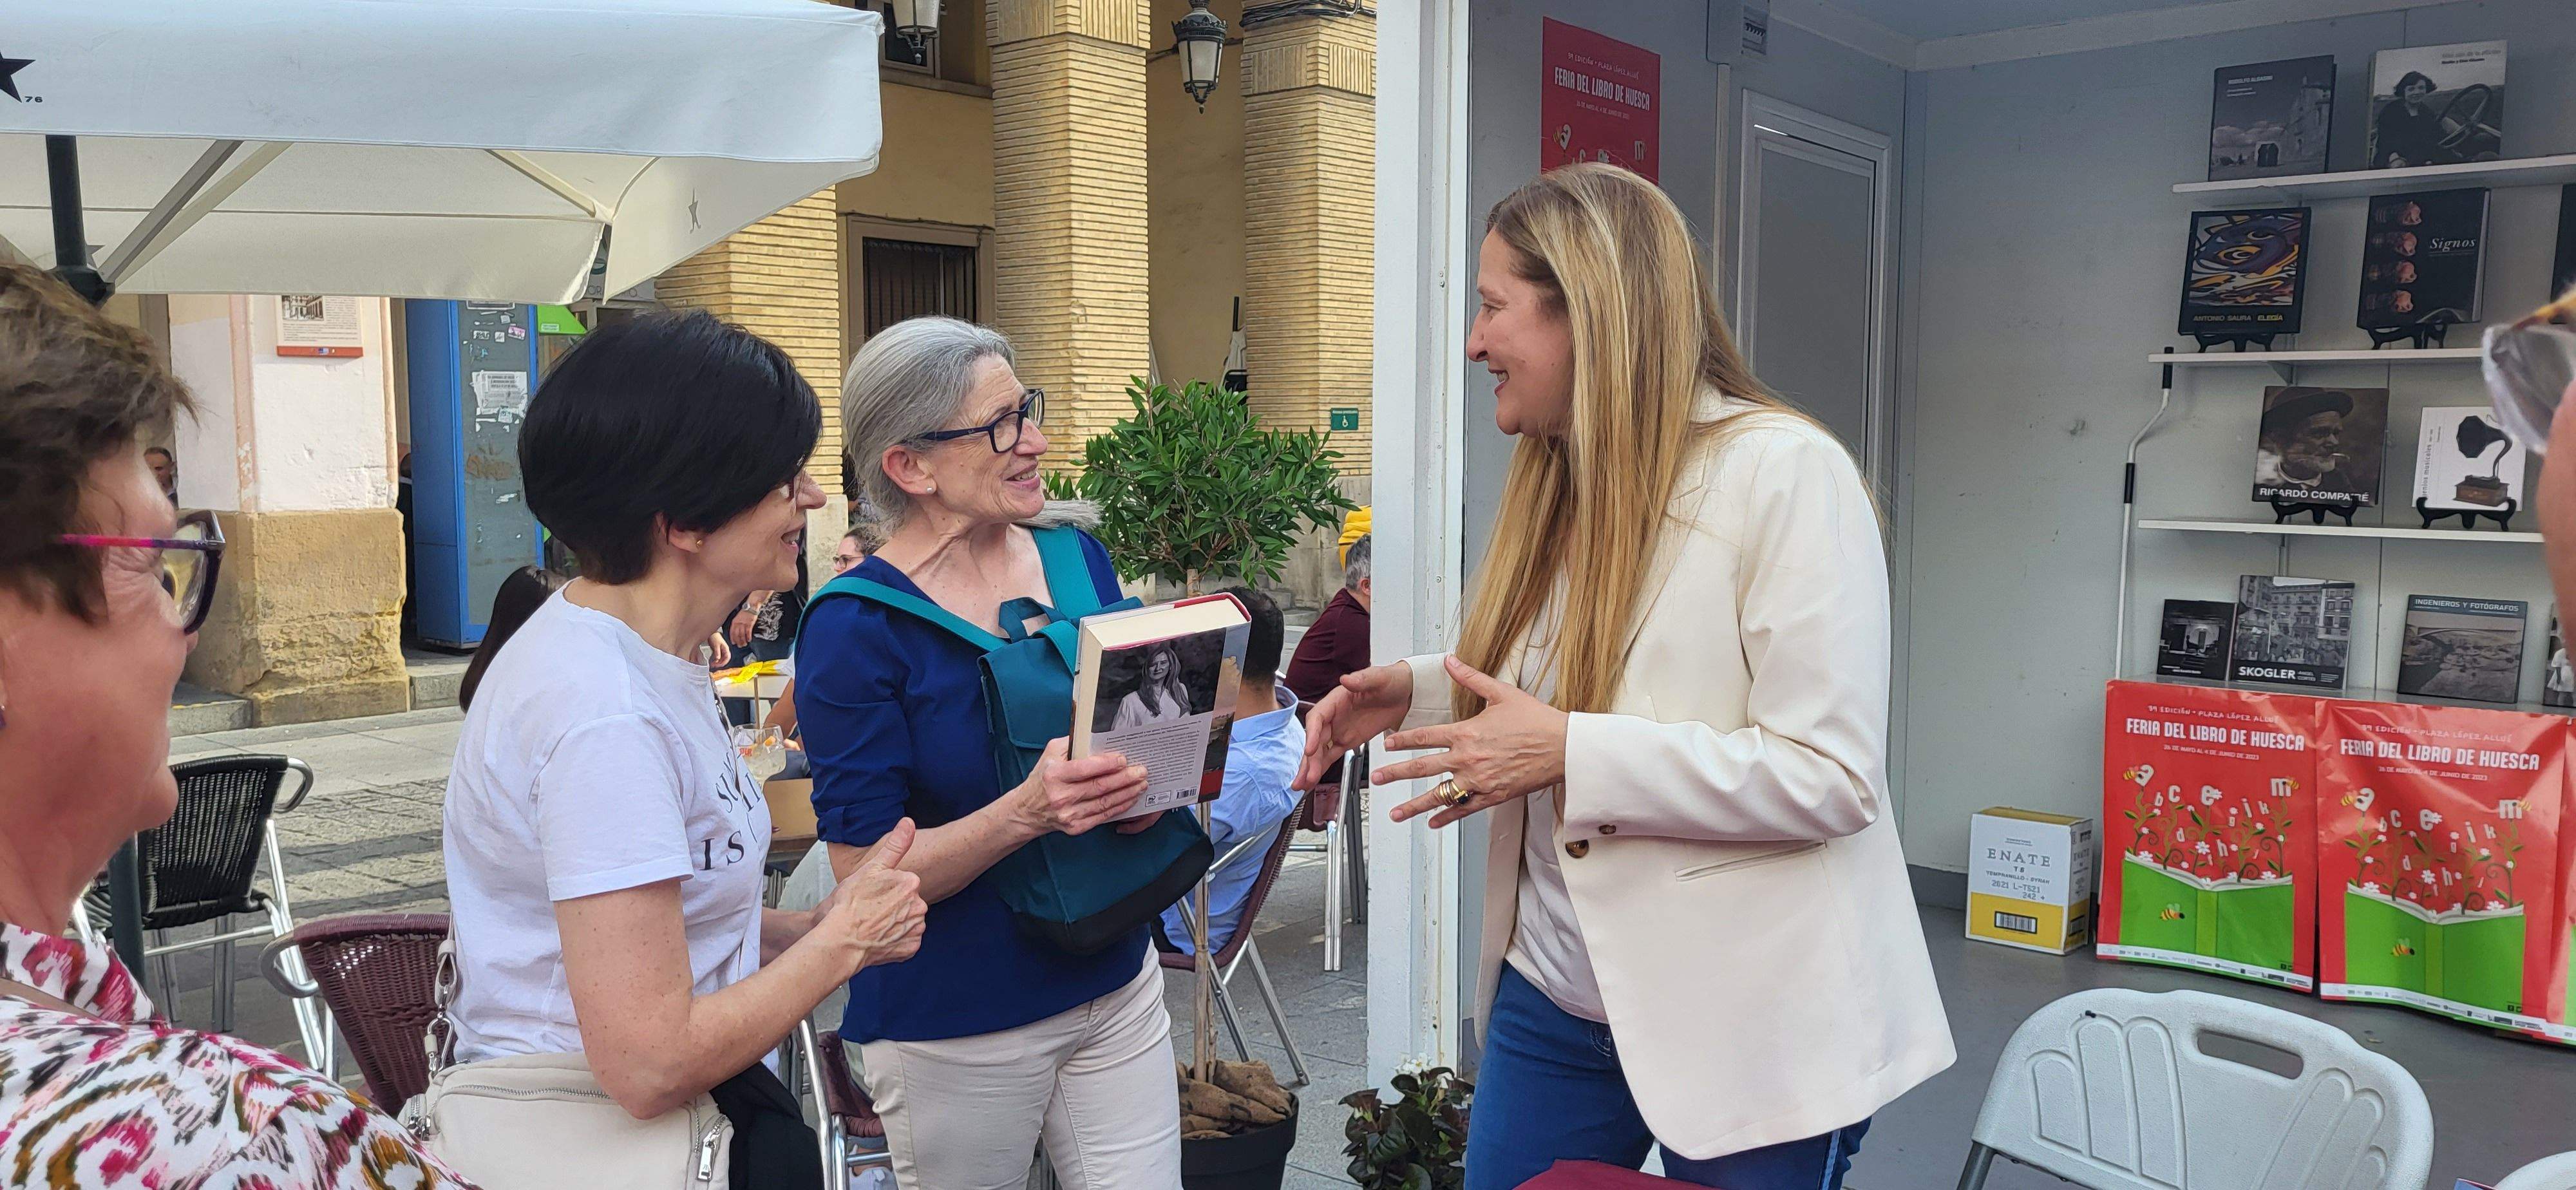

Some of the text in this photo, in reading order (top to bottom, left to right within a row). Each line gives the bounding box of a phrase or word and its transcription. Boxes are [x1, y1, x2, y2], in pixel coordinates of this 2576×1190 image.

[1555, 67, 1650, 111] FERIA DEL LIBRO DE HUESCA
[2430, 238, 2476, 252] Signos
[2415, 598, 2460, 608] INGENIEROS
[2470, 601, 2519, 612] FOTÓGRAFOS
[2238, 666, 2296, 679] SKOGLER
[2227, 711, 2251, 722] LÓPEZ
[2126, 717, 2306, 751] FERIA DEL LIBRO DE HUESCA
[2452, 730, 2481, 740] LÓPEZ
[2339, 739, 2540, 771] FERIA DEL LIBRO DE HUESCA
[699, 829, 745, 871] IS
[1987, 847, 2051, 867] ENATE
[1985, 870, 2025, 881] TEMPRANILLO
[1991, 880, 2009, 889] 2021
[2022, 891, 2037, 900] 242
